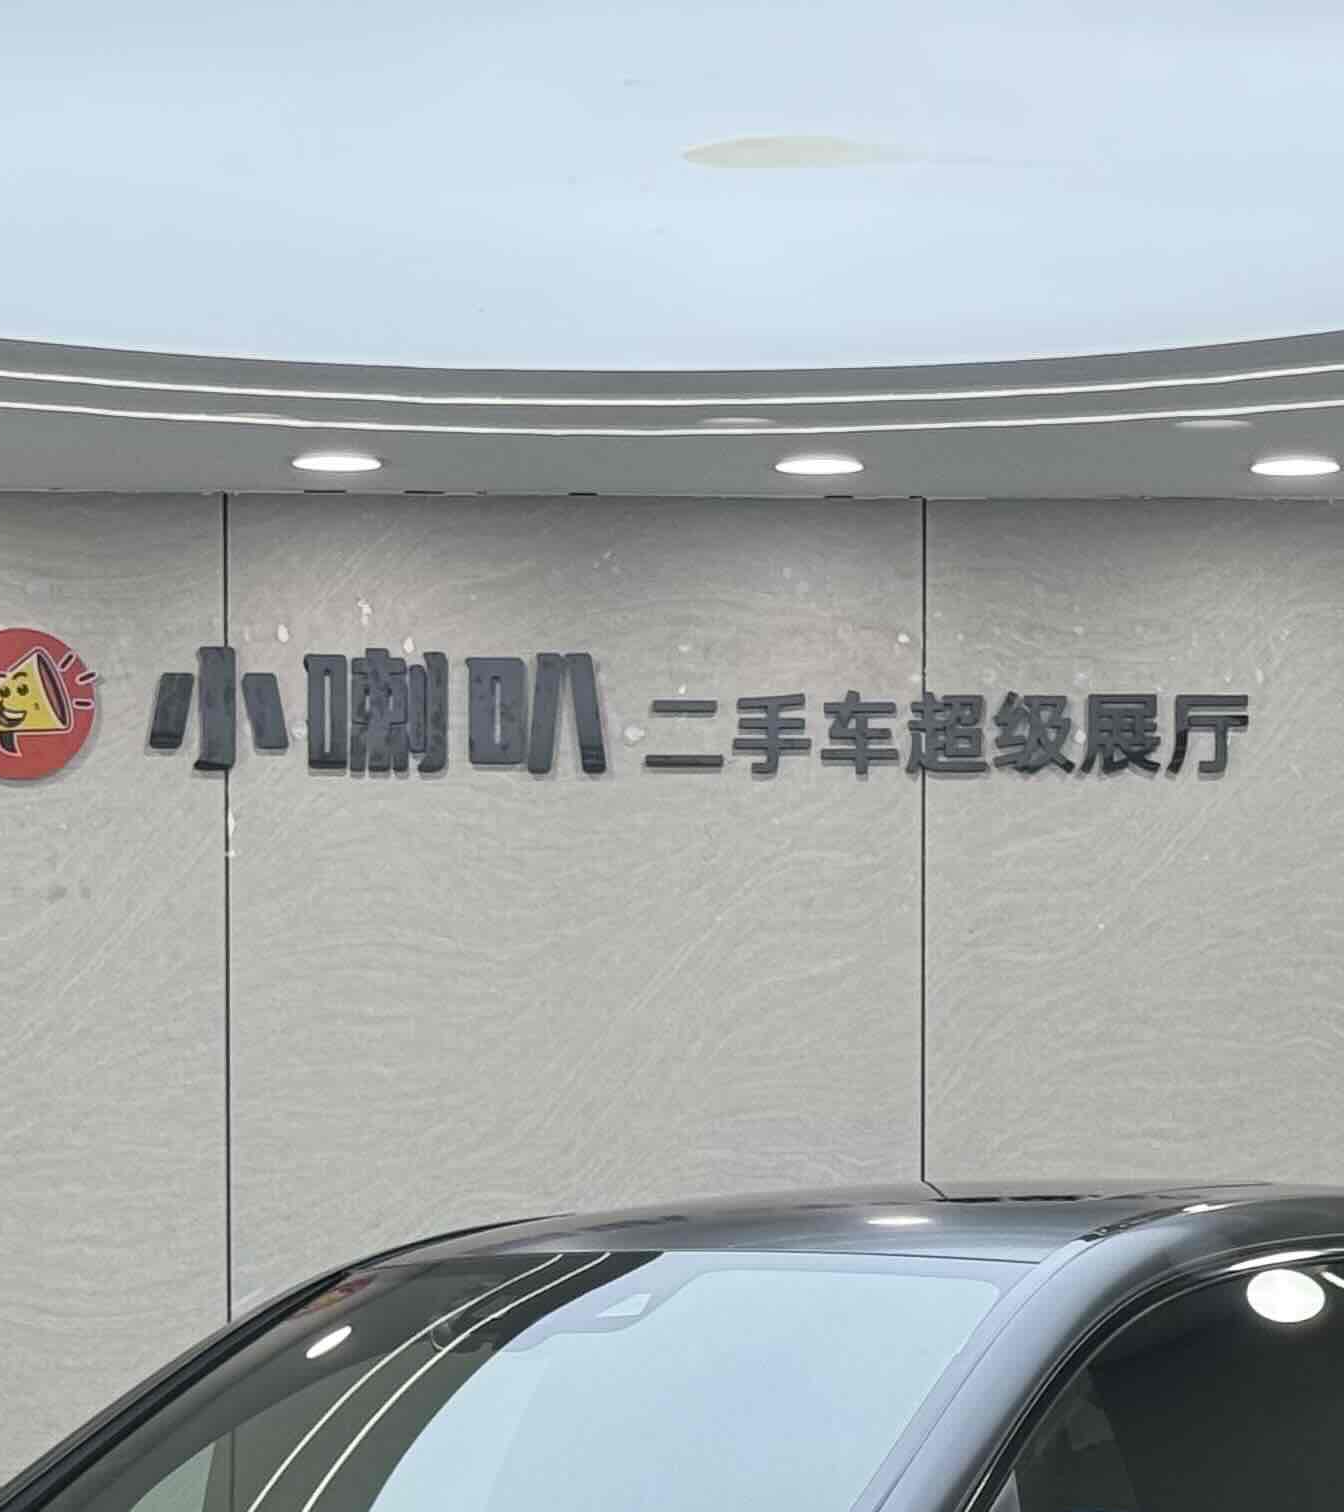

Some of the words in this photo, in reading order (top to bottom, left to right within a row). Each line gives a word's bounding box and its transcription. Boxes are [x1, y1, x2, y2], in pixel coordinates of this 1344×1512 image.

[149, 646, 607, 774] 小喇叭
[645, 690, 1249, 776] 二手车超级展厅
